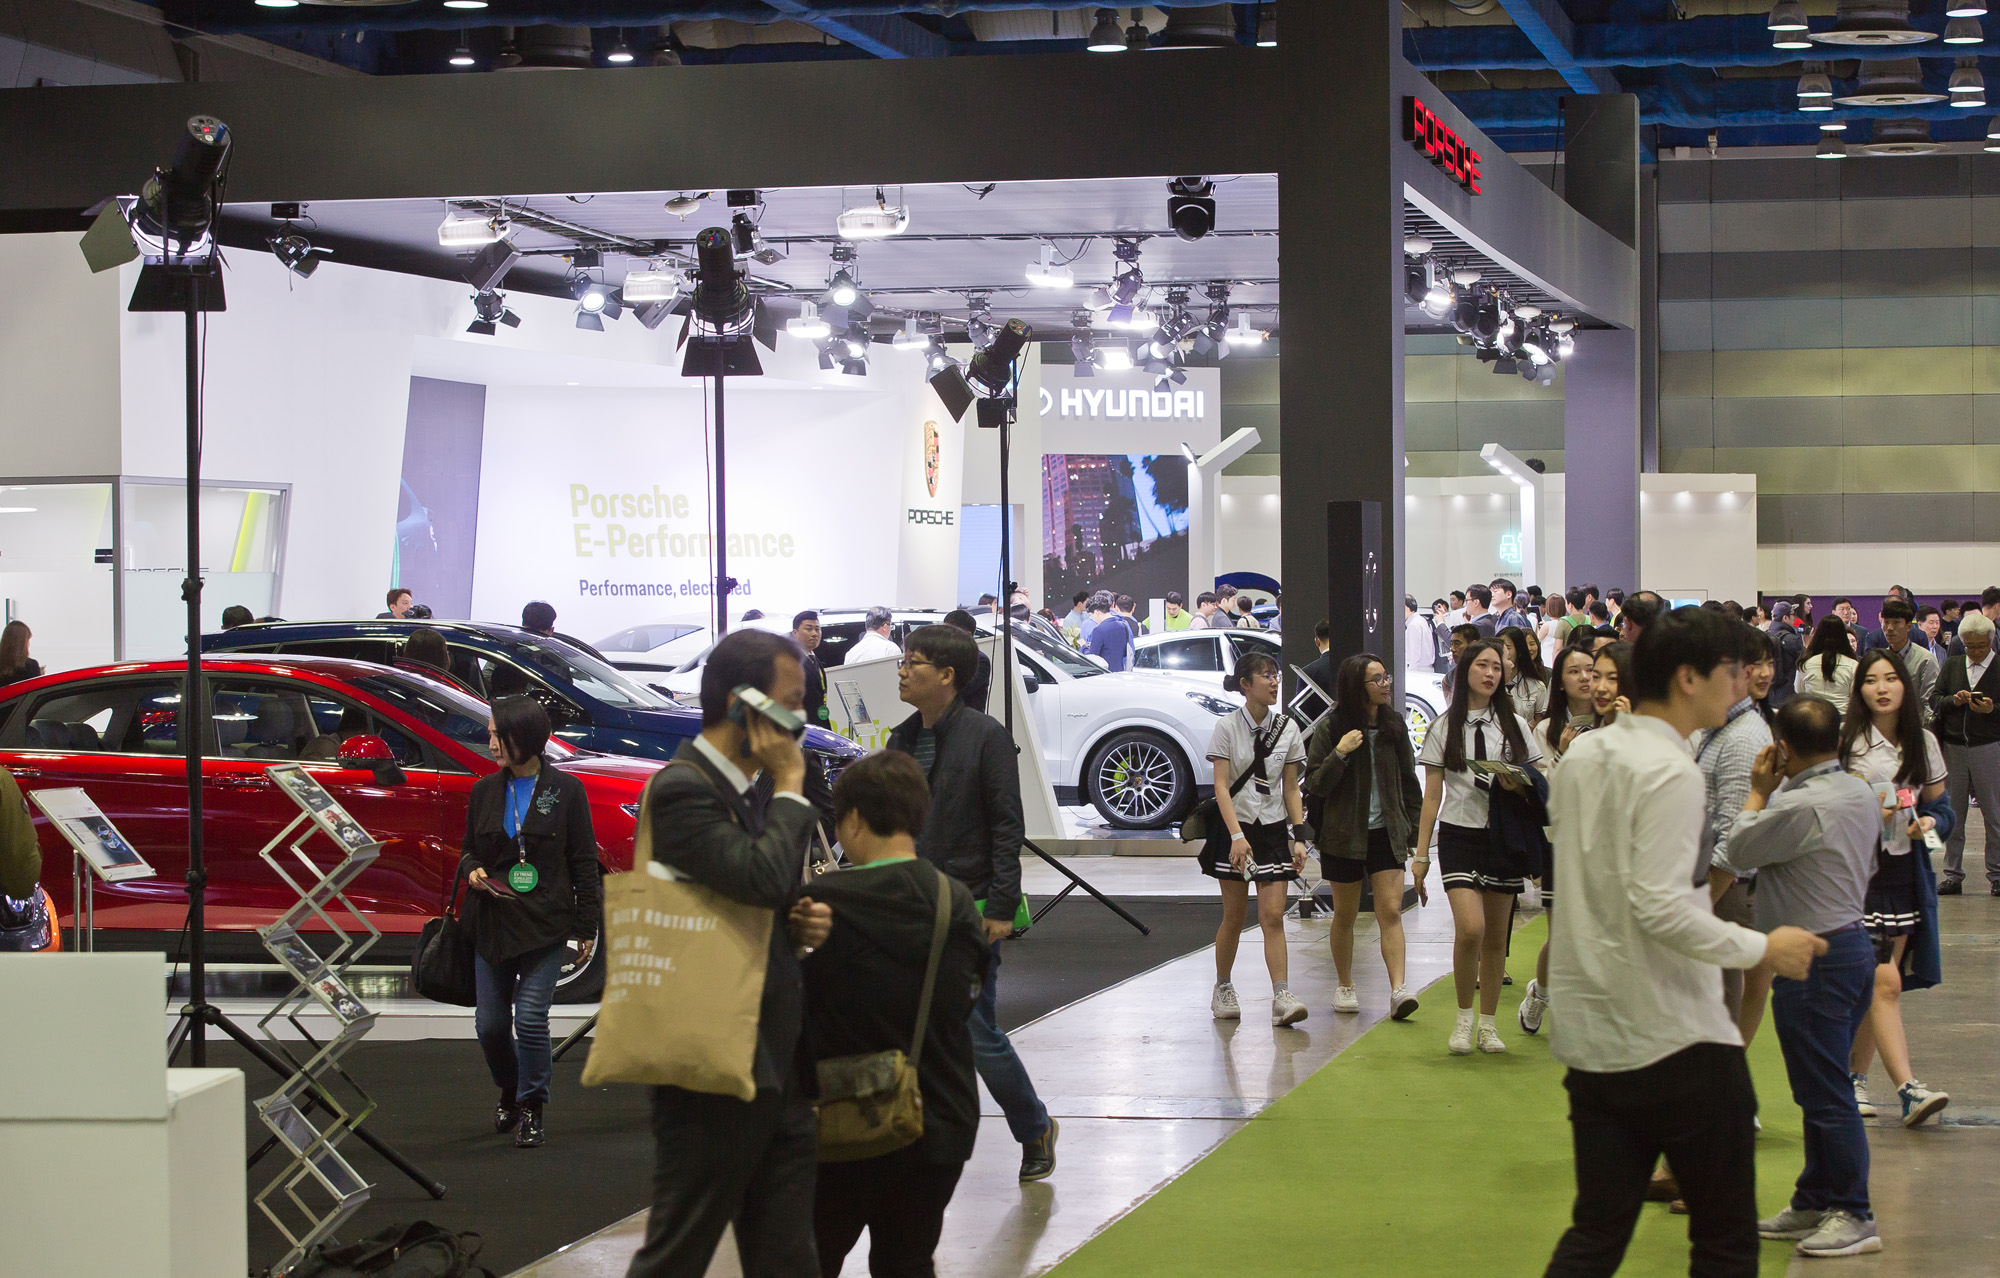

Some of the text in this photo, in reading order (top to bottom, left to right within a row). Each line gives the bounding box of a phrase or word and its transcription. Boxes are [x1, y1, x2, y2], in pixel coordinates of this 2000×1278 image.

[1412, 96, 1481, 195] PORSCHE
[1061, 388, 1204, 418] HYUNDAI
[570, 484, 689, 518] Porsche
[908, 508, 953, 525] PORSCHE
[574, 523, 795, 557] E-Performance
[579, 579, 752, 598] Performance, elected
